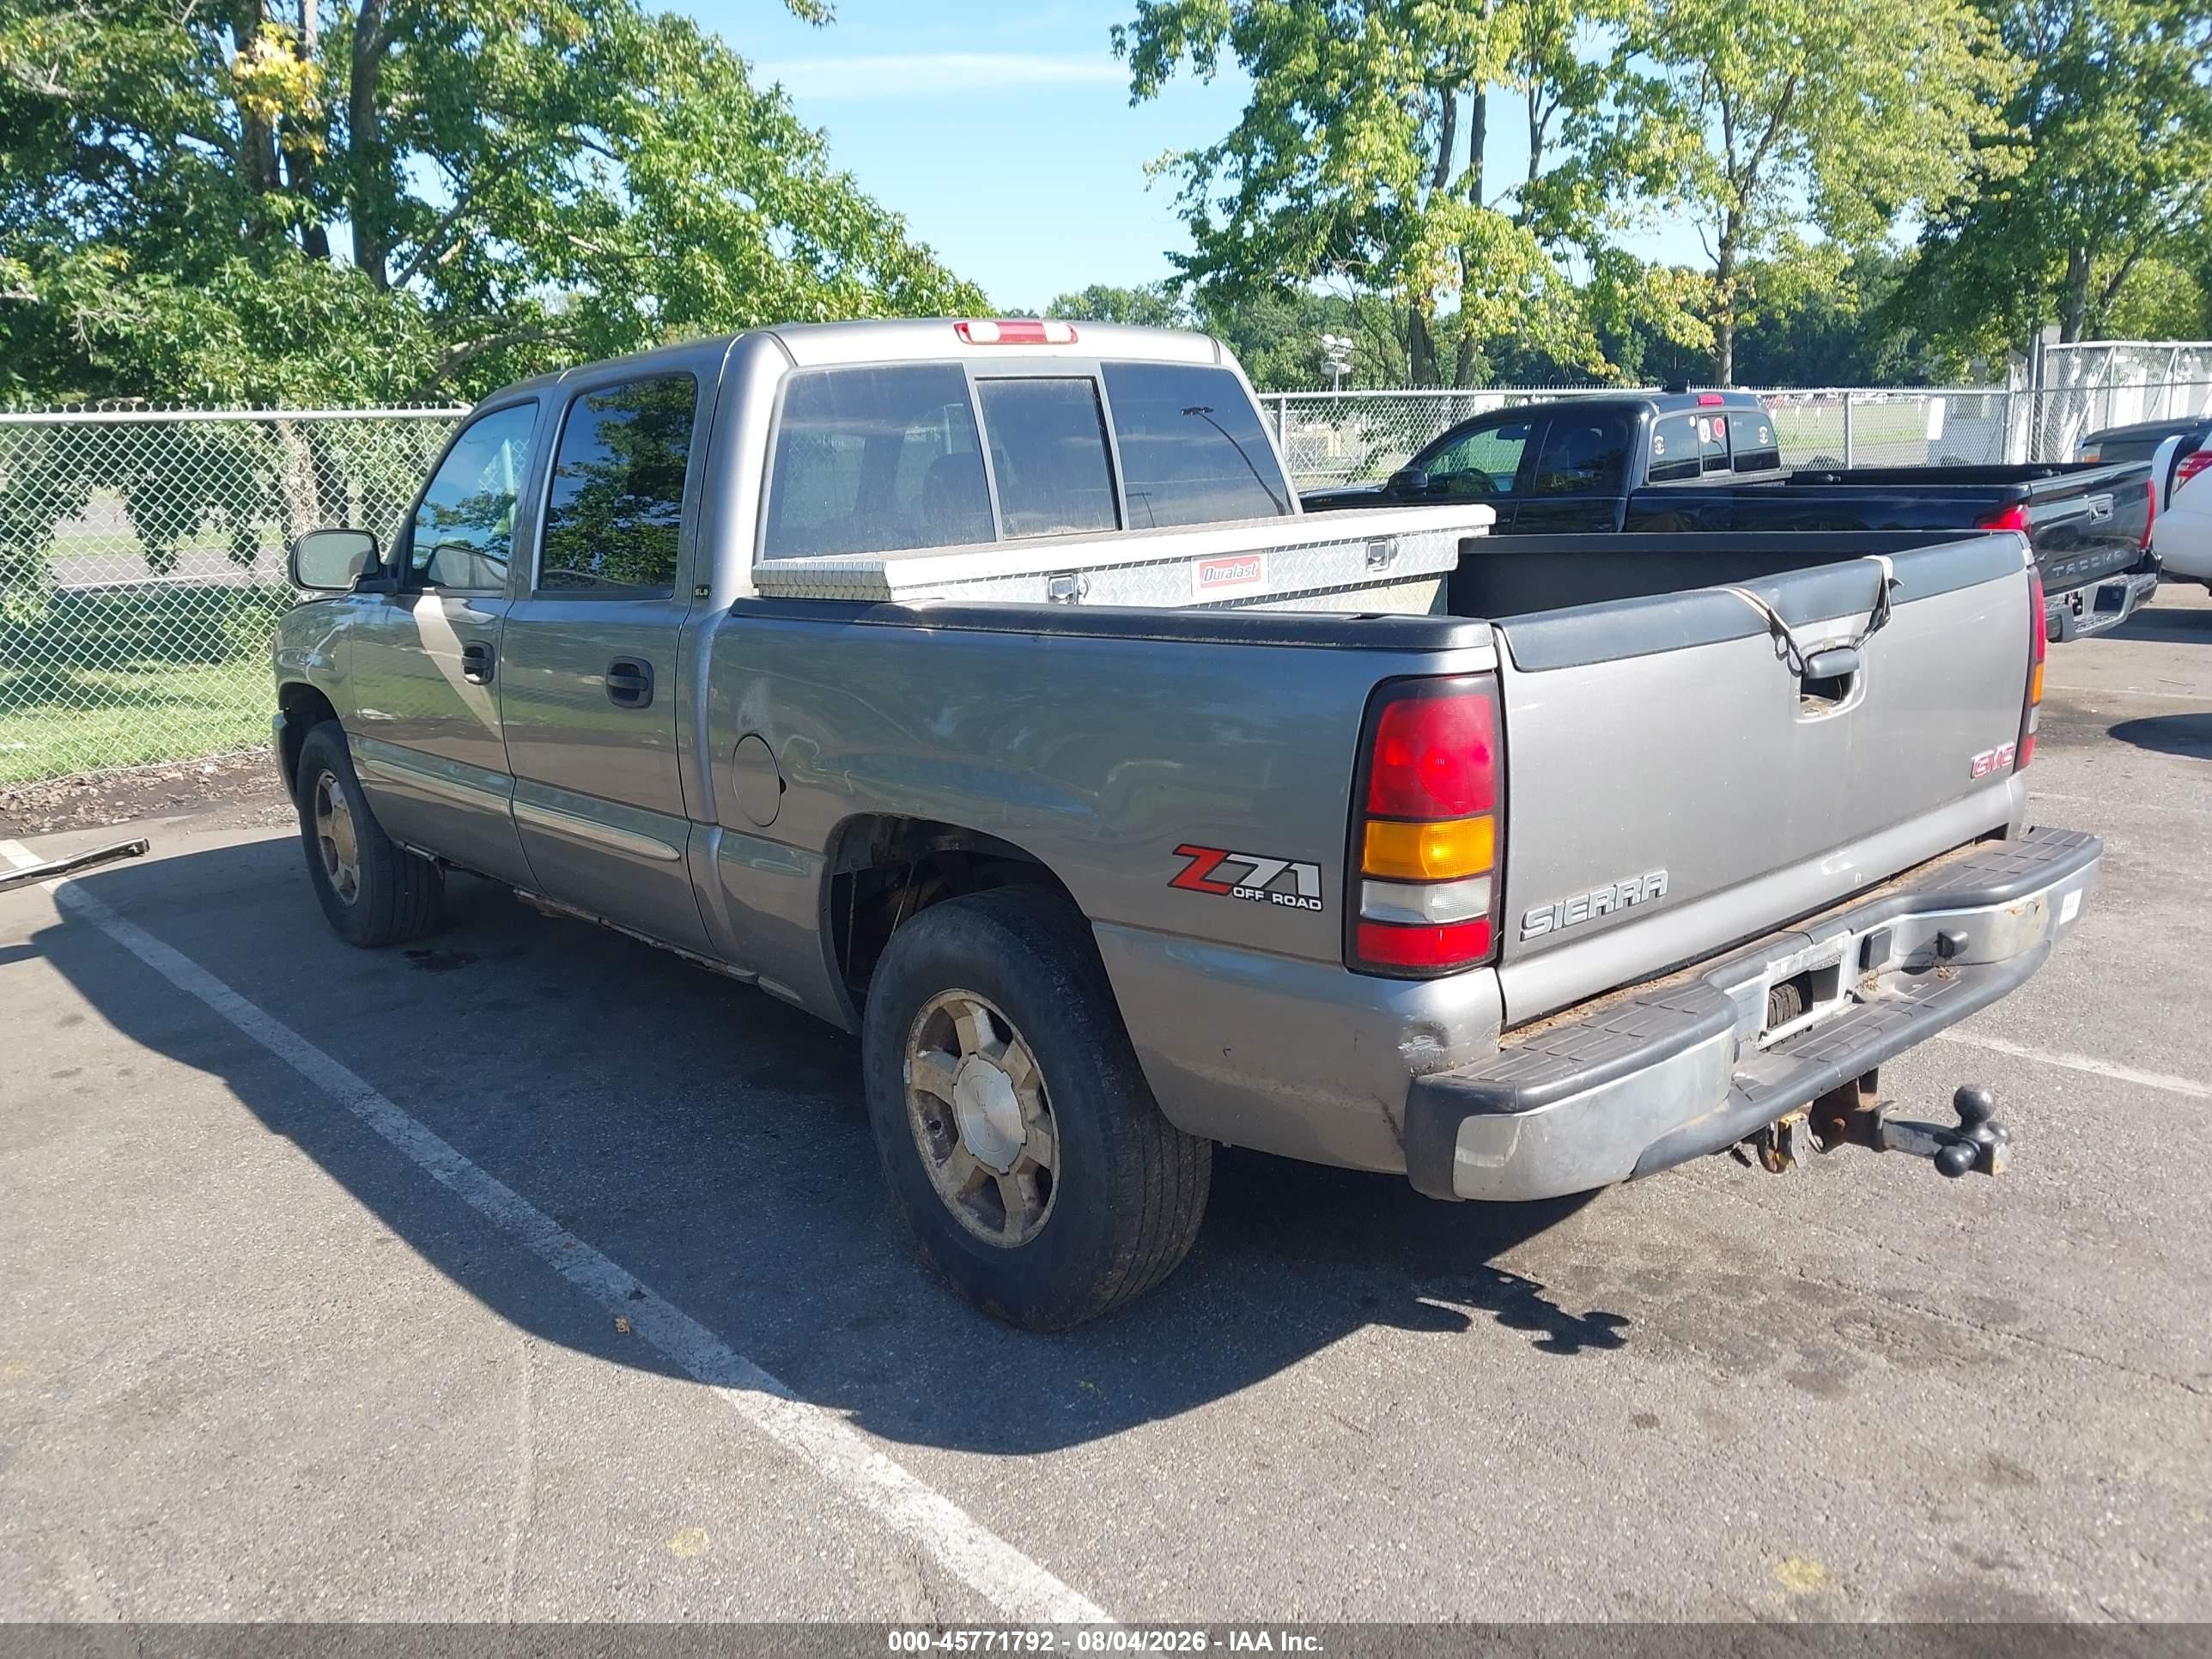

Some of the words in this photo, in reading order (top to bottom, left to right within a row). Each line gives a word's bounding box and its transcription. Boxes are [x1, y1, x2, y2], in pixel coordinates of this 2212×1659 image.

[1203, 562, 1257, 582] Duralast
[1972, 742, 2014, 780] GMC
[1168, 844, 1322, 897] Z71
[1232, 887, 1265, 901] OFF
[1272, 893, 1322, 910] ROAD
[1520, 870, 1668, 942] SIERRA
